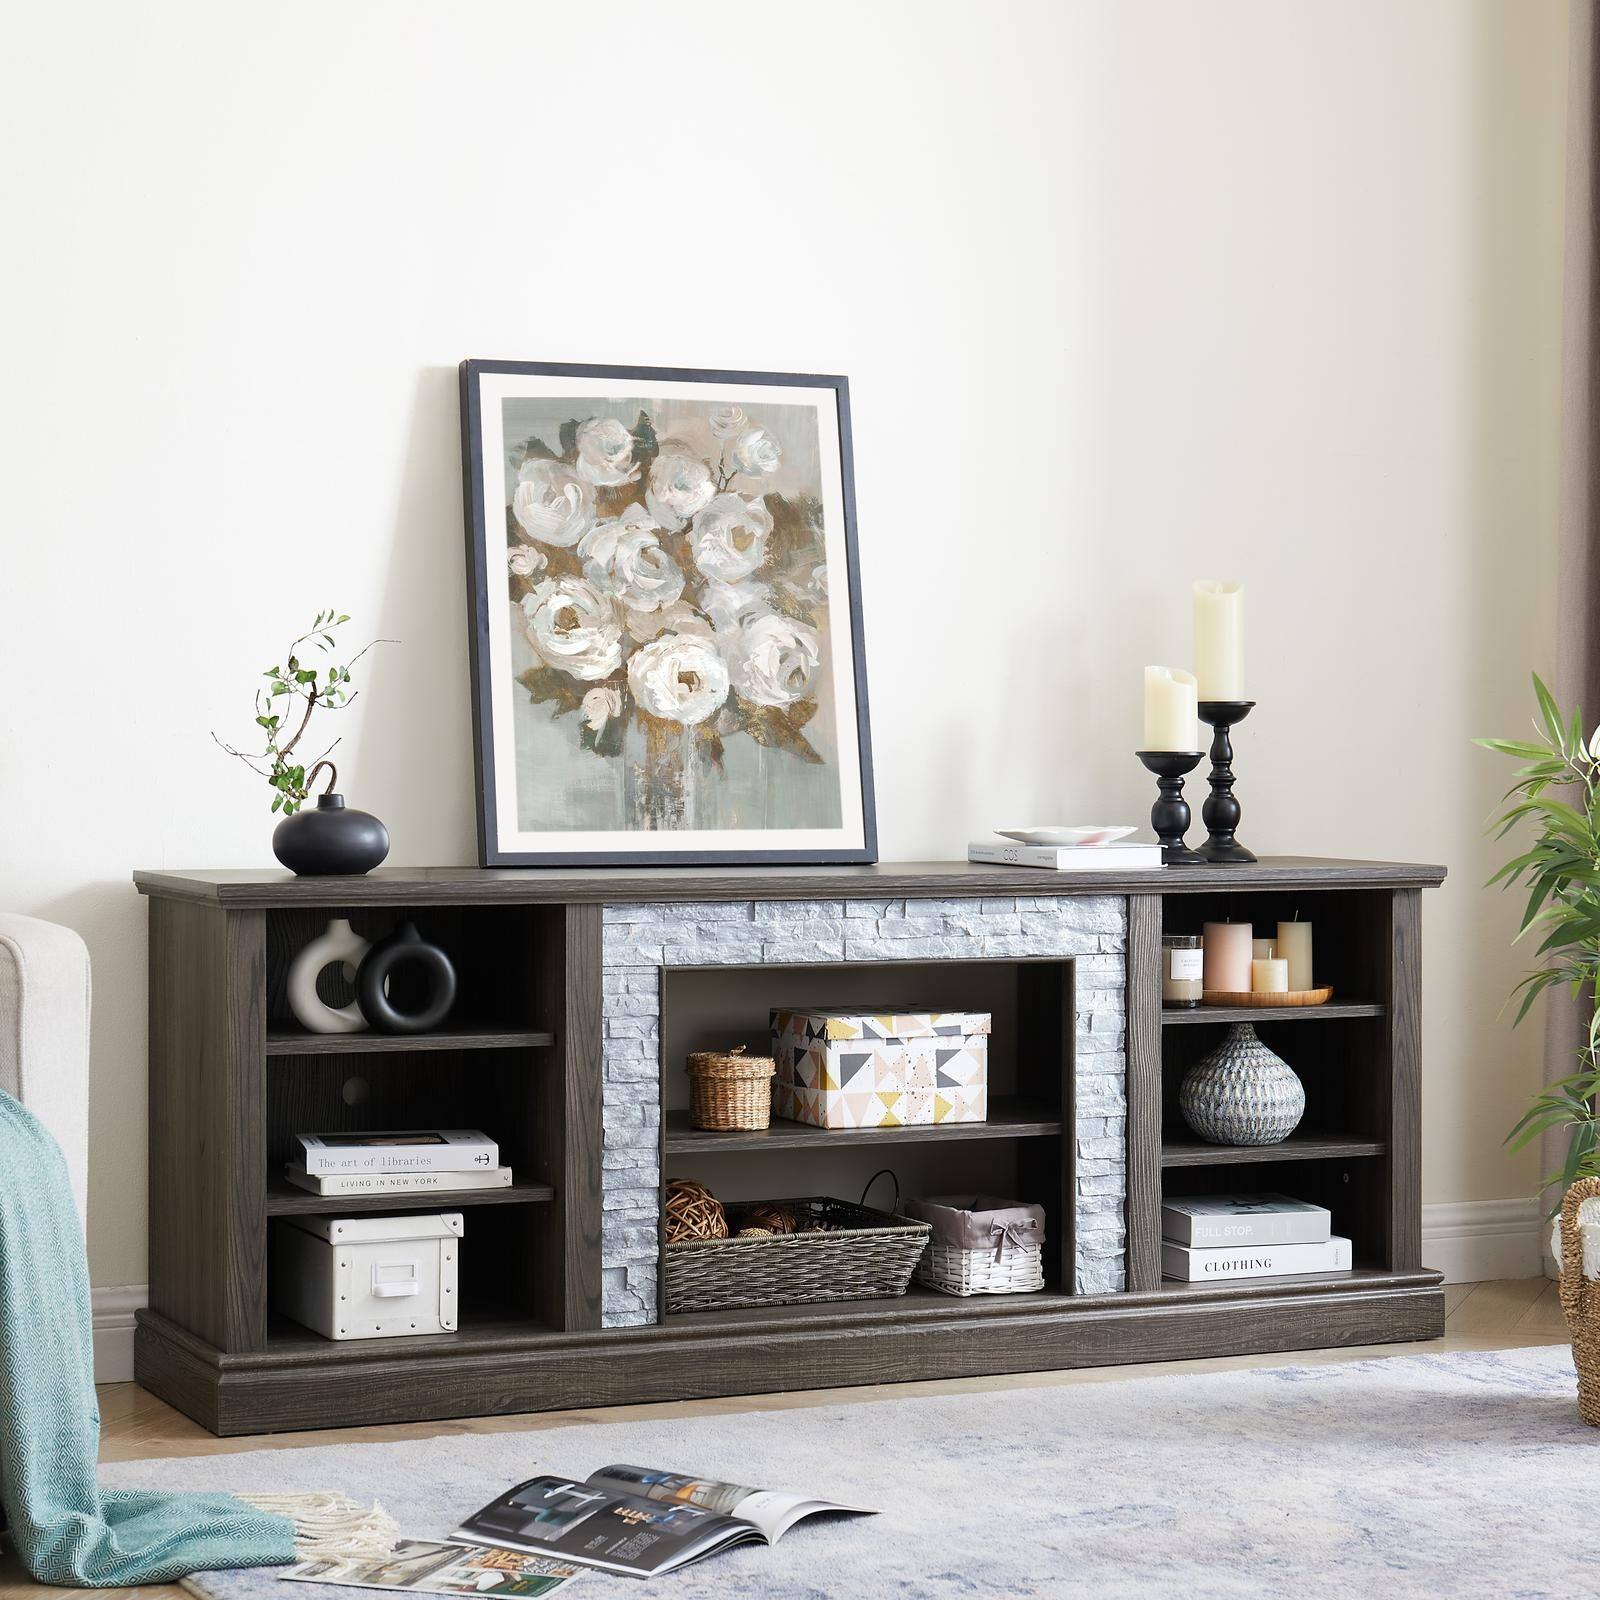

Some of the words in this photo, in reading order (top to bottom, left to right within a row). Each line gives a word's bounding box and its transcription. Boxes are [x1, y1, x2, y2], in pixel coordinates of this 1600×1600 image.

[319, 1158, 336, 1168] The
[341, 1158, 357, 1167] art
[363, 1157, 375, 1167] of
[382, 1156, 432, 1166] libraries
[341, 1180, 371, 1188] LIVING
[414, 1177, 438, 1185] YORK
[1194, 1226, 1221, 1238] FULL
[1224, 1224, 1254, 1236] STOP.
[1204, 1258, 1272, 1273] CLOTHING
